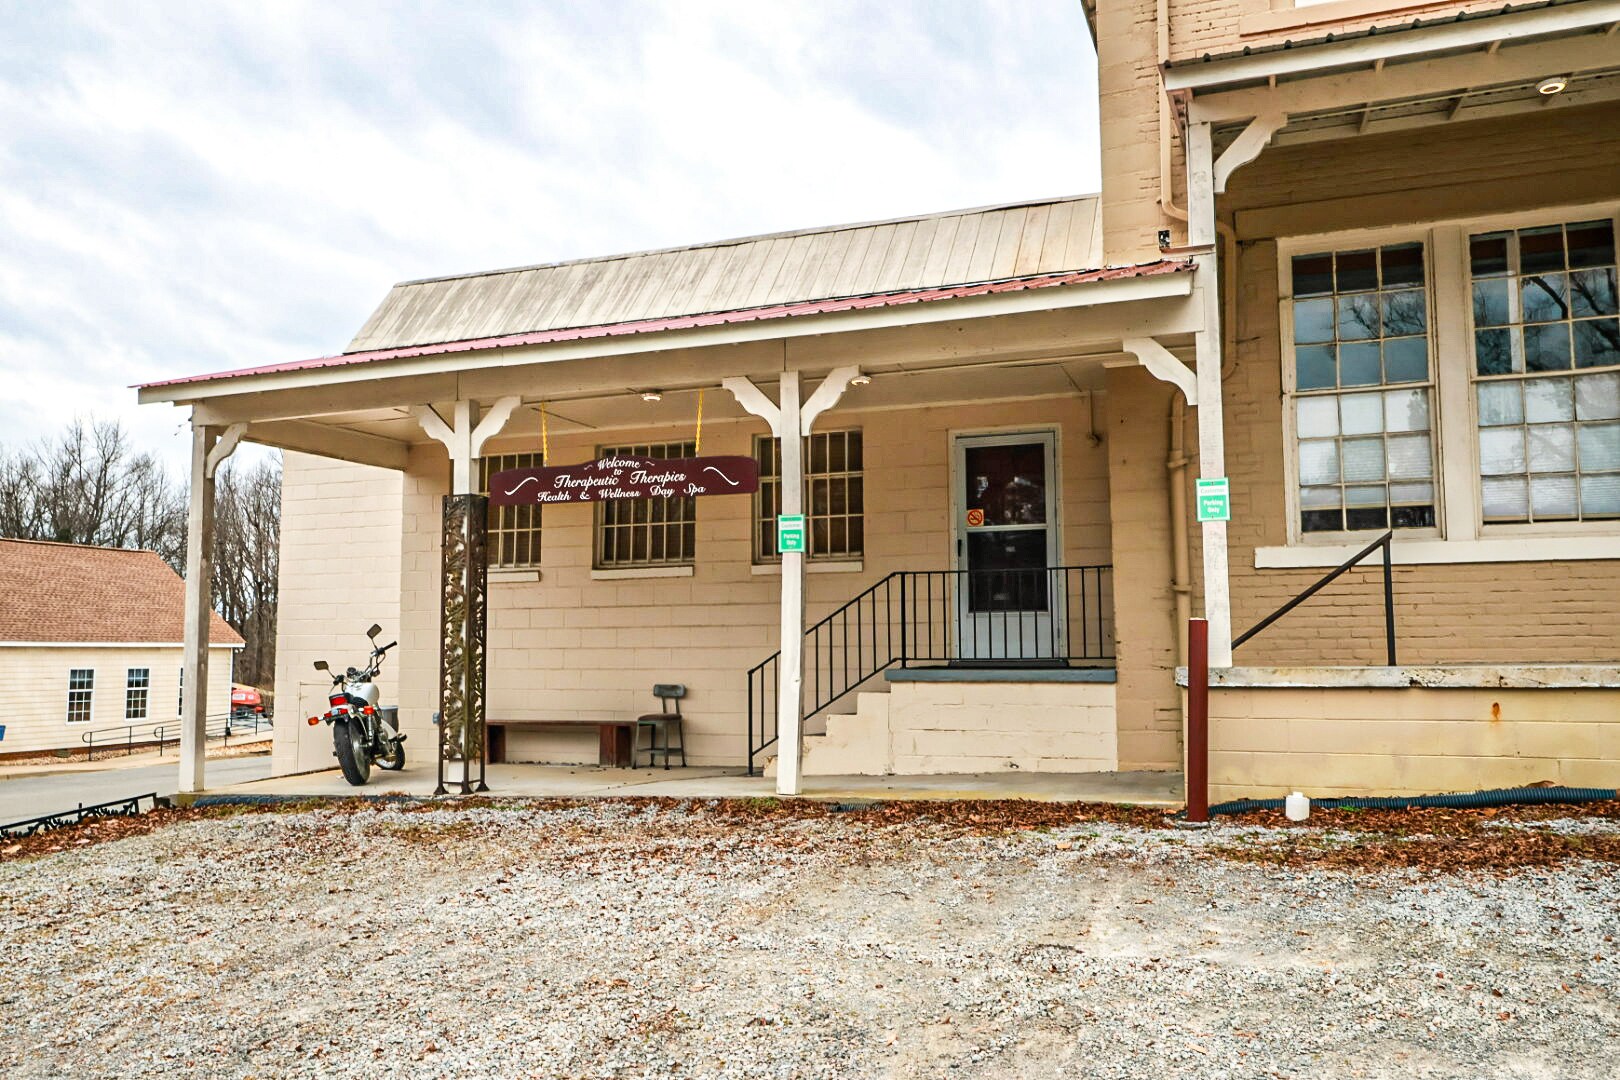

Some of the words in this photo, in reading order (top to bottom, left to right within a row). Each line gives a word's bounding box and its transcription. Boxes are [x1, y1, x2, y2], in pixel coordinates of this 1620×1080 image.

[597, 456, 641, 470] Welcome
[553, 474, 620, 491] Therapeutic
[629, 470, 687, 487] Therapies
[613, 468, 624, 476] to
[537, 490, 572, 502] Health
[579, 491, 591, 500] &
[598, 487, 642, 499] Wellness
[649, 484, 675, 498] Day
[683, 482, 706, 497] Spa
